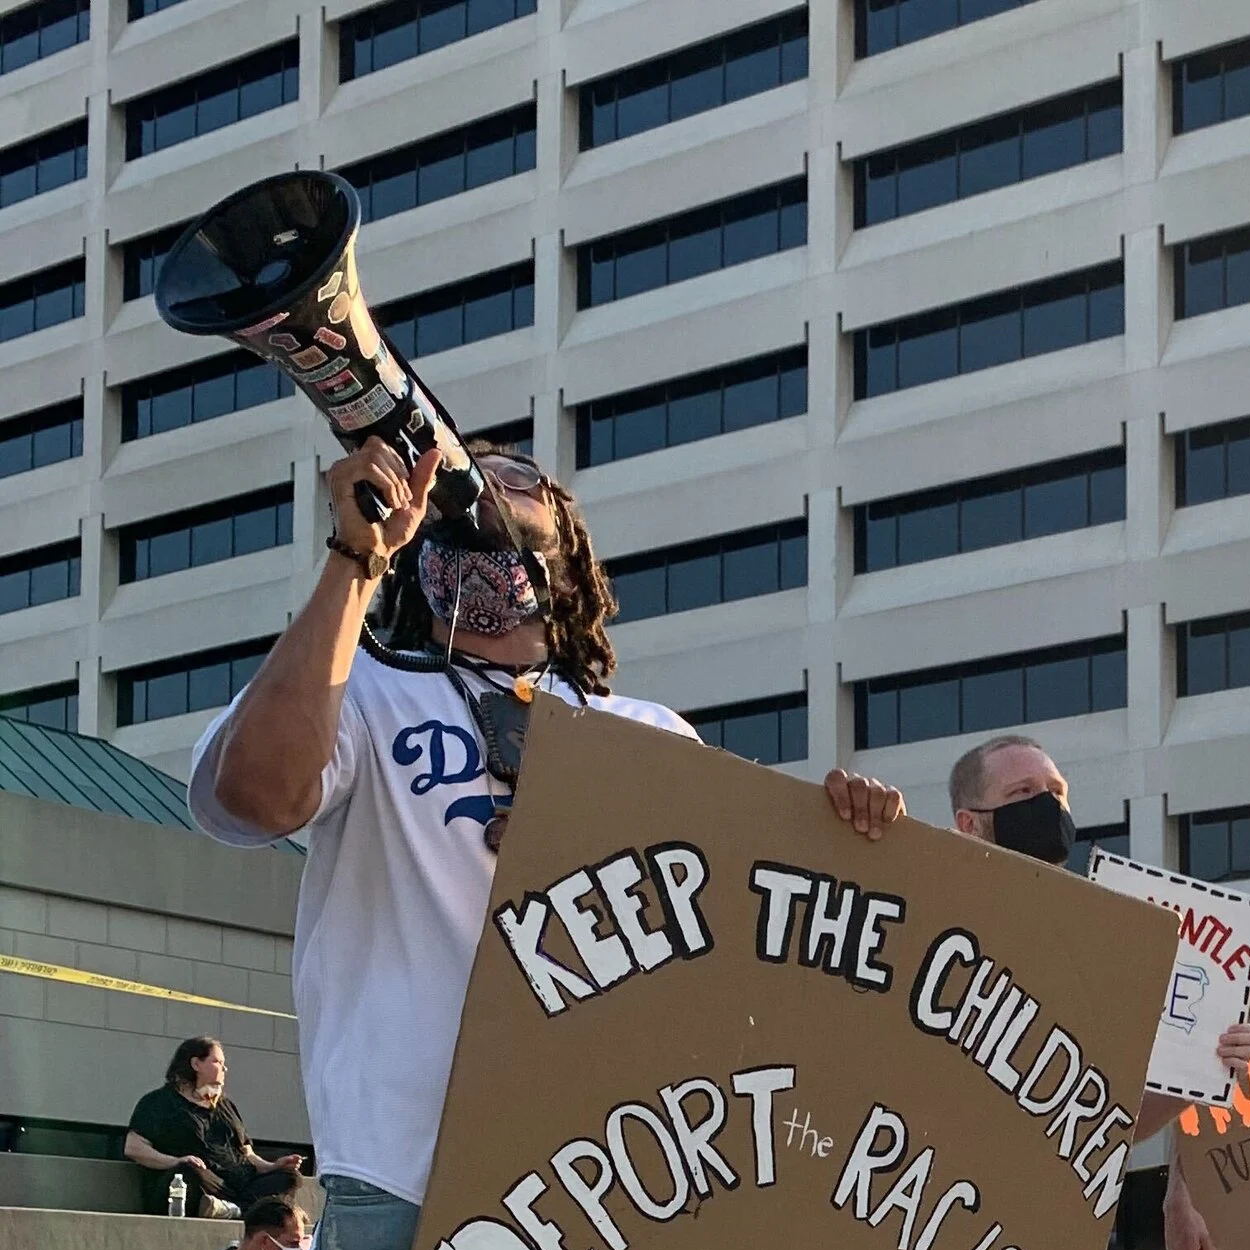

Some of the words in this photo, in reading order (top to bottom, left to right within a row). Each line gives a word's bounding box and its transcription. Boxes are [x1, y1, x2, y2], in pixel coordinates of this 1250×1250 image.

[392, 719, 487, 796] D
[1164, 972, 1202, 1024] E
[492, 840, 715, 1020] KEEP
[748, 859, 907, 994] THE
[909, 926, 1136, 1221] CHILDREN
[781, 1108, 836, 1159] the
